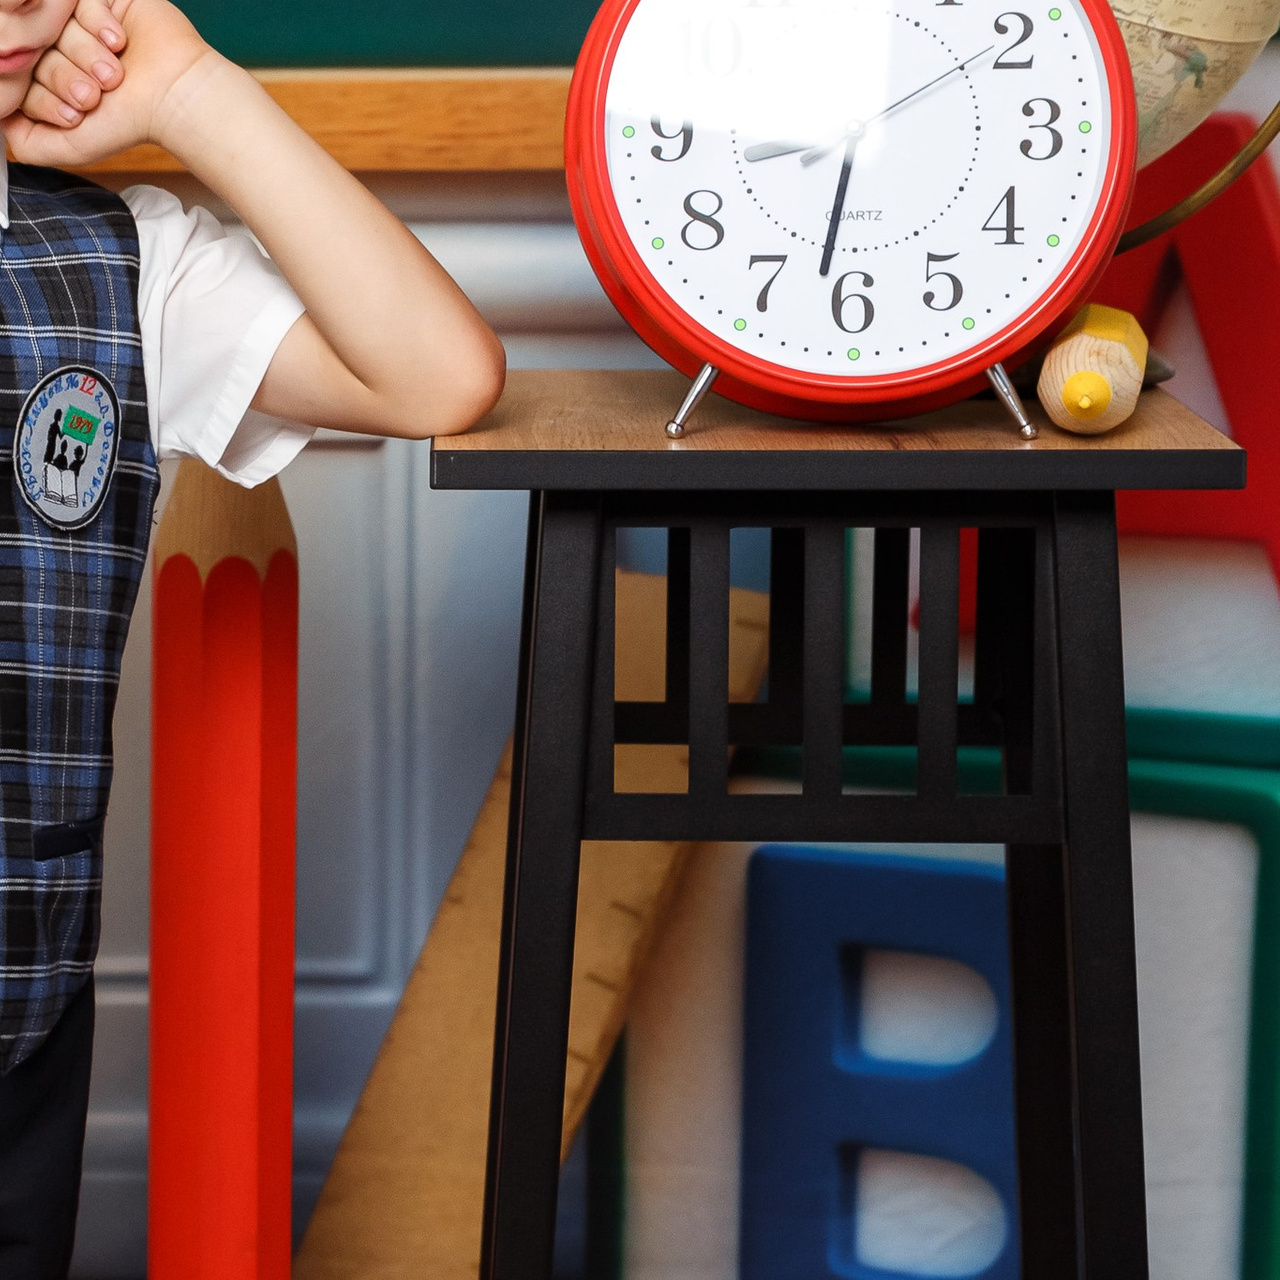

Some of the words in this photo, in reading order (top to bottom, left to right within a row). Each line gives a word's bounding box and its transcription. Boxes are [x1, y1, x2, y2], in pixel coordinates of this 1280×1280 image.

[992, 11, 1035, 70] 2
[650, 111, 694, 162] 9
[1019, 97, 1063, 160] 3
[680, 189, 725, 252] 8
[980, 185, 1025, 246] 4
[747, 254, 789, 313] 7
[830, 271, 875, 334] 6
[922, 251, 964, 312] 5
